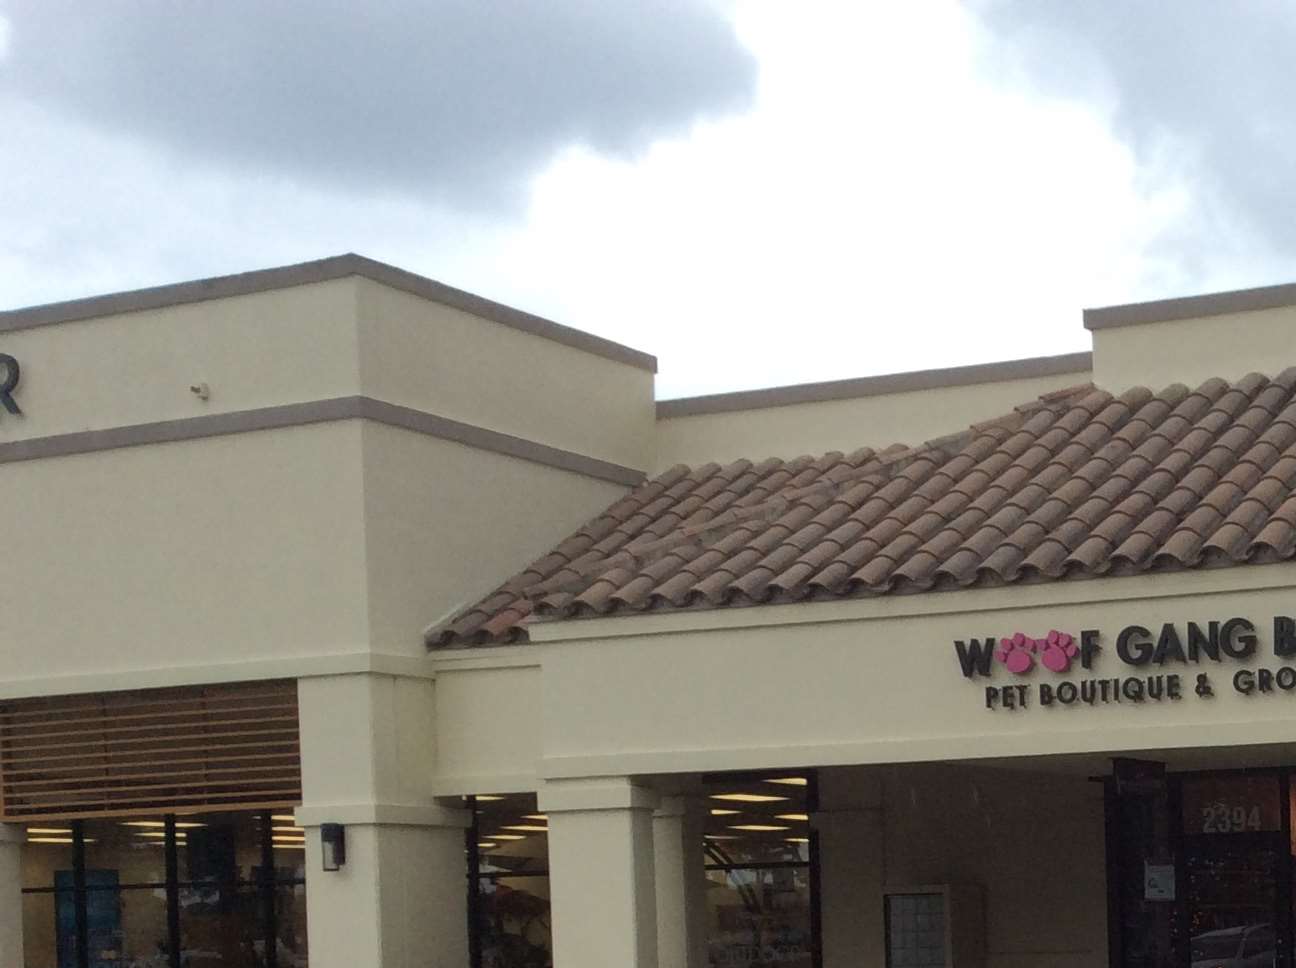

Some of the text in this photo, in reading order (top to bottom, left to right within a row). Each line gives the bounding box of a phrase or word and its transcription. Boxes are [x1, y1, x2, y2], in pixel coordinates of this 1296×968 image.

[1116, 617, 1257, 665] GANG
[985, 683, 1030, 709] PET
[1039, 674, 1182, 706] BOUTIQUE
[1195, 672, 1214, 698] &
[1203, 806, 1262, 833] 2394
